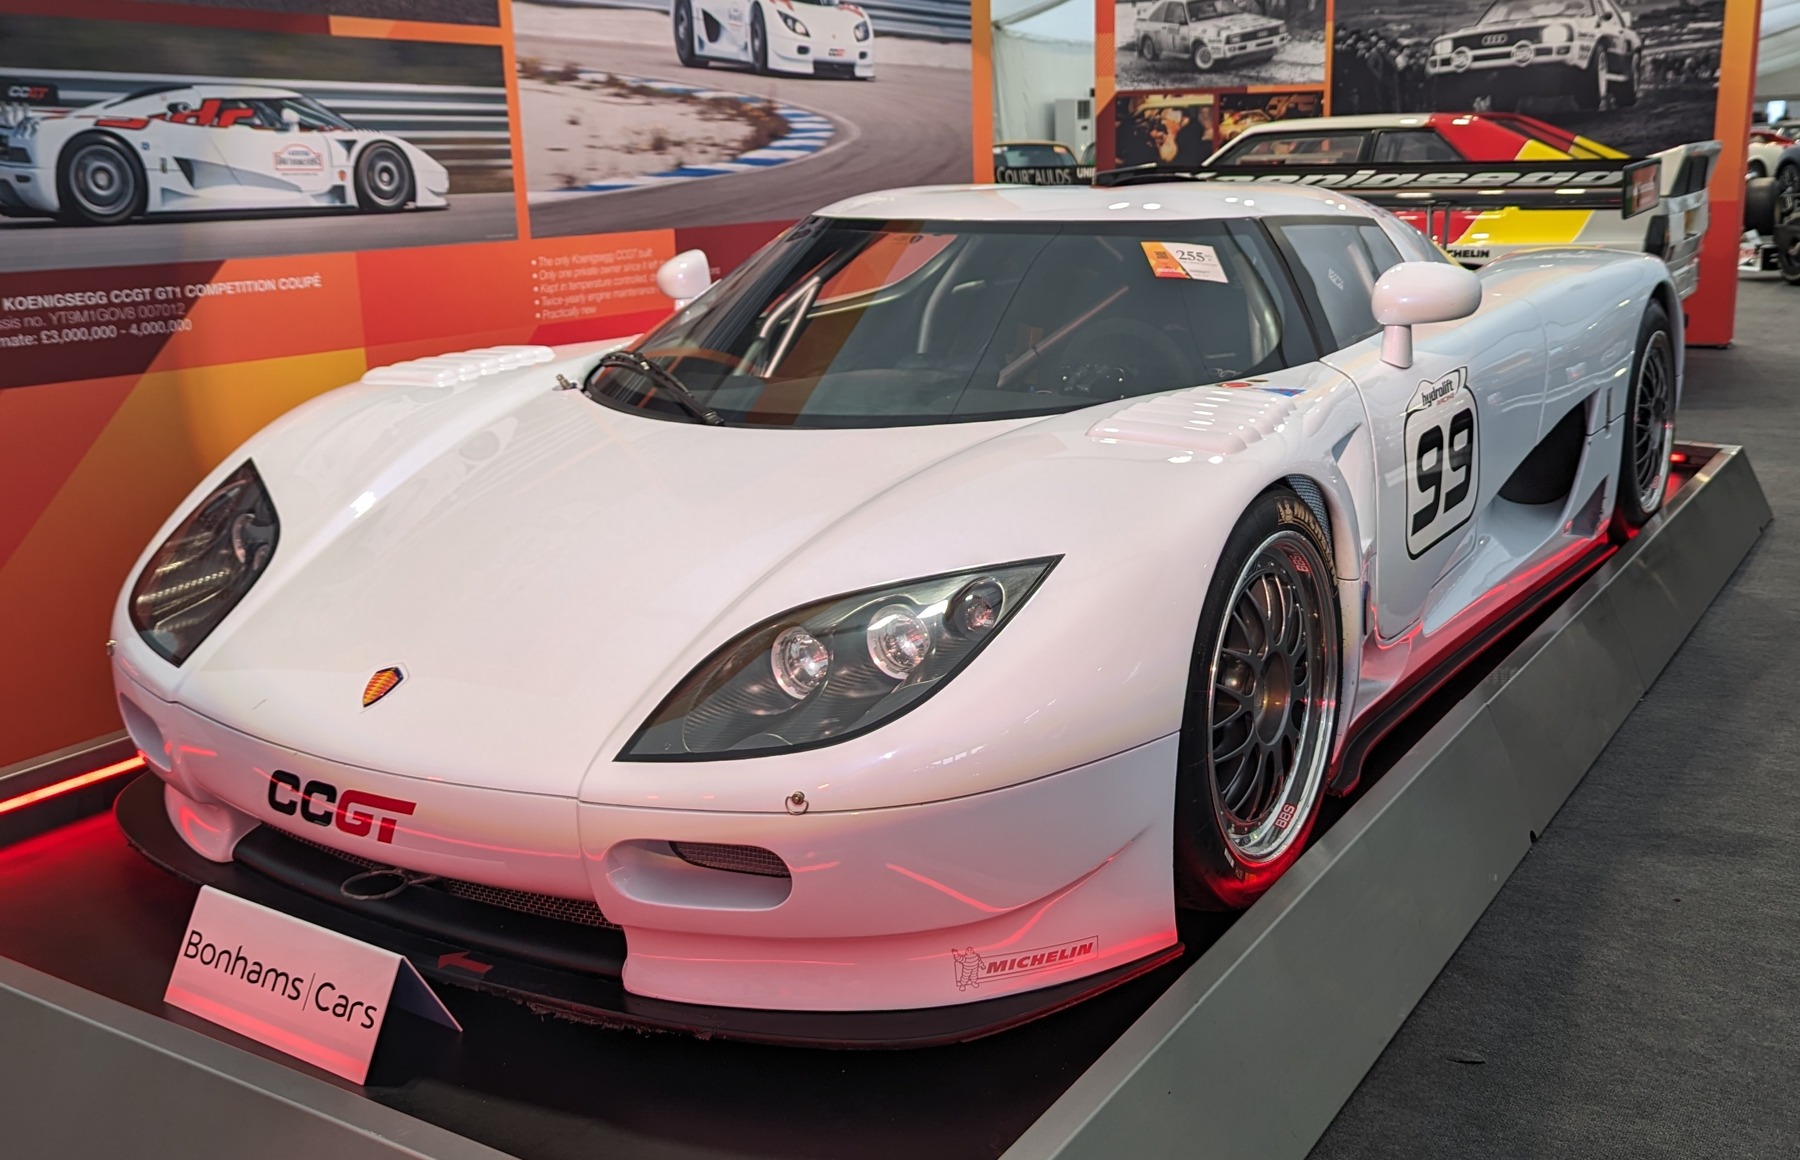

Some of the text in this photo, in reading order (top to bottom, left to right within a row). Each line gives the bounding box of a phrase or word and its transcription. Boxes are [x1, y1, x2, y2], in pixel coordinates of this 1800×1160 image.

[1175, 249, 1205, 262] 255
[2, 272, 322, 311] KOENIGSEGG CCGT GT1 COMPETITION COUPÉ
[23, 315, 47, 328] no.
[40, 325, 117, 345] £3,000,000
[128, 318, 193, 338] 4,000,000
[1421, 379, 1454, 407] hydrolift
[1411, 407, 1474, 537] 99
[267, 769, 417, 844] CCGT
[1275, 804, 1296, 829] BBS
[986, 942, 1094, 974] MICHELIN
[183, 929, 378, 1030] Bonhams Cars
